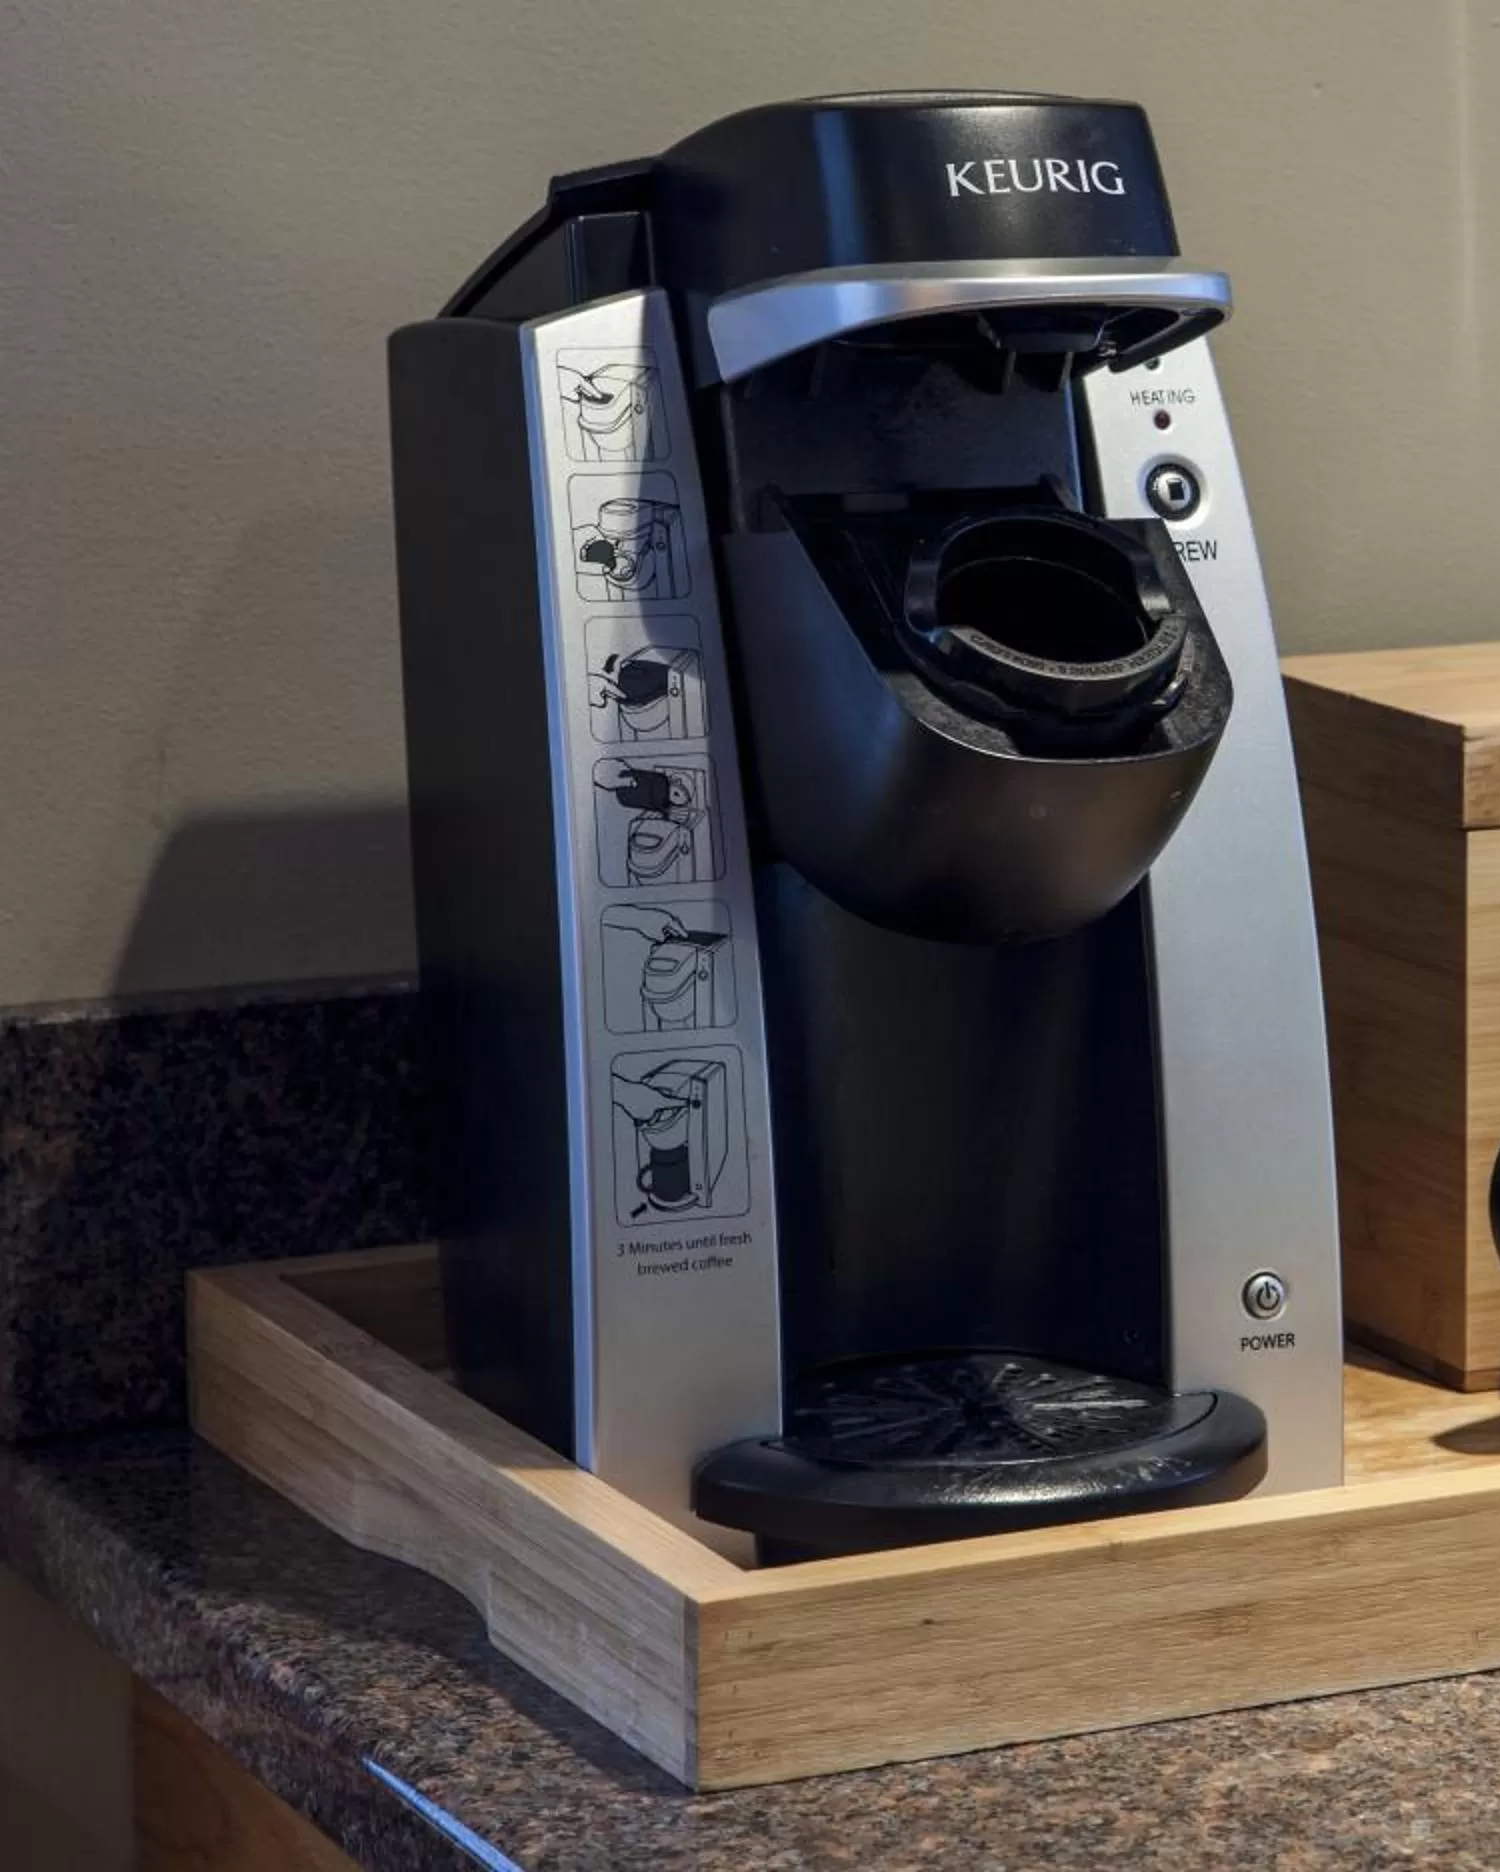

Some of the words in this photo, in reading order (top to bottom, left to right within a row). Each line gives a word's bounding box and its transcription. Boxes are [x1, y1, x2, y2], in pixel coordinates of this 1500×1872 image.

[945, 159, 1126, 198] KEURIG
[1129, 389, 1197, 405] HEATING
[1171, 540, 1218, 562] REW
[616, 1243, 626, 1257] 3
[628, 1239, 684, 1256] Minutes
[685, 1234, 718, 1250] until
[719, 1231, 753, 1247] fresh
[637, 1257, 689, 1277] brewed
[690, 1255, 734, 1272] coffee
[1240, 1332, 1296, 1352] POWER
